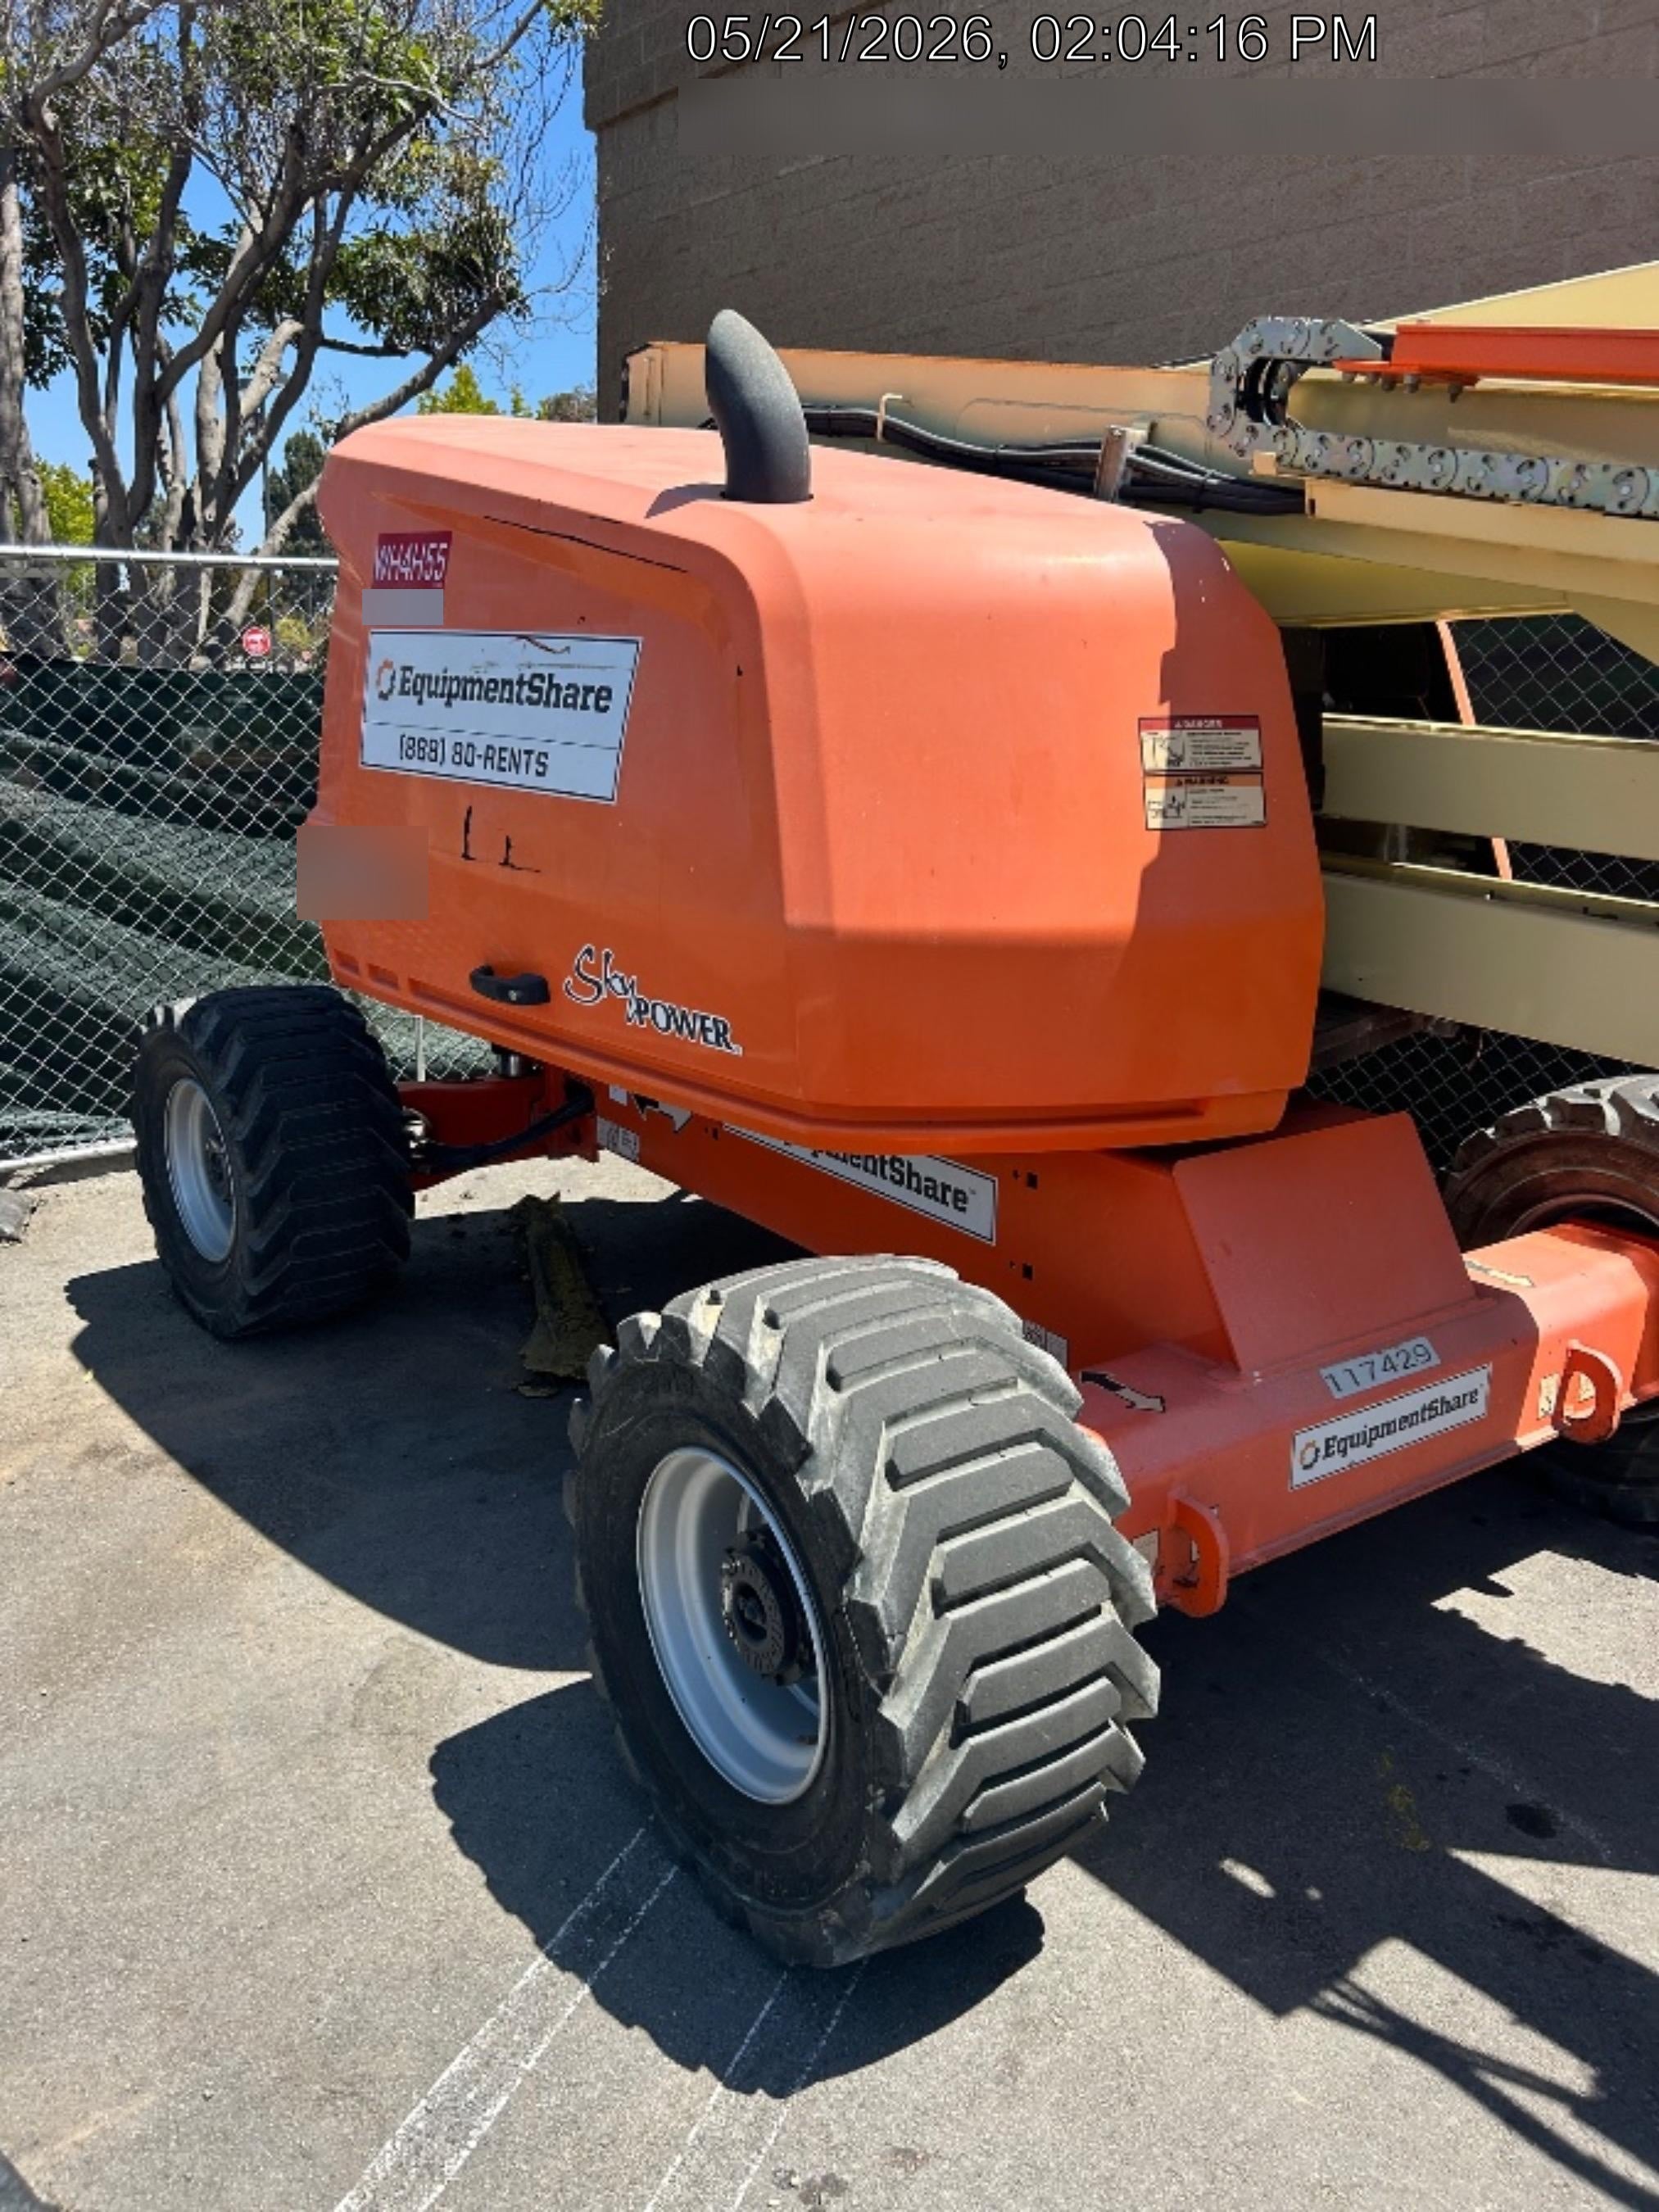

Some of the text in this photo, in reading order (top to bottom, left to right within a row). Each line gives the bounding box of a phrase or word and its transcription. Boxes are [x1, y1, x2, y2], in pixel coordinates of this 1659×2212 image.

[399, 665, 613, 714] EquipmentShare
[451, 741, 549, 777] 80-RENTS
[1324, 1343, 1433, 1393] 117429
[1322, 1389, 1480, 1461] EquipmentShare
